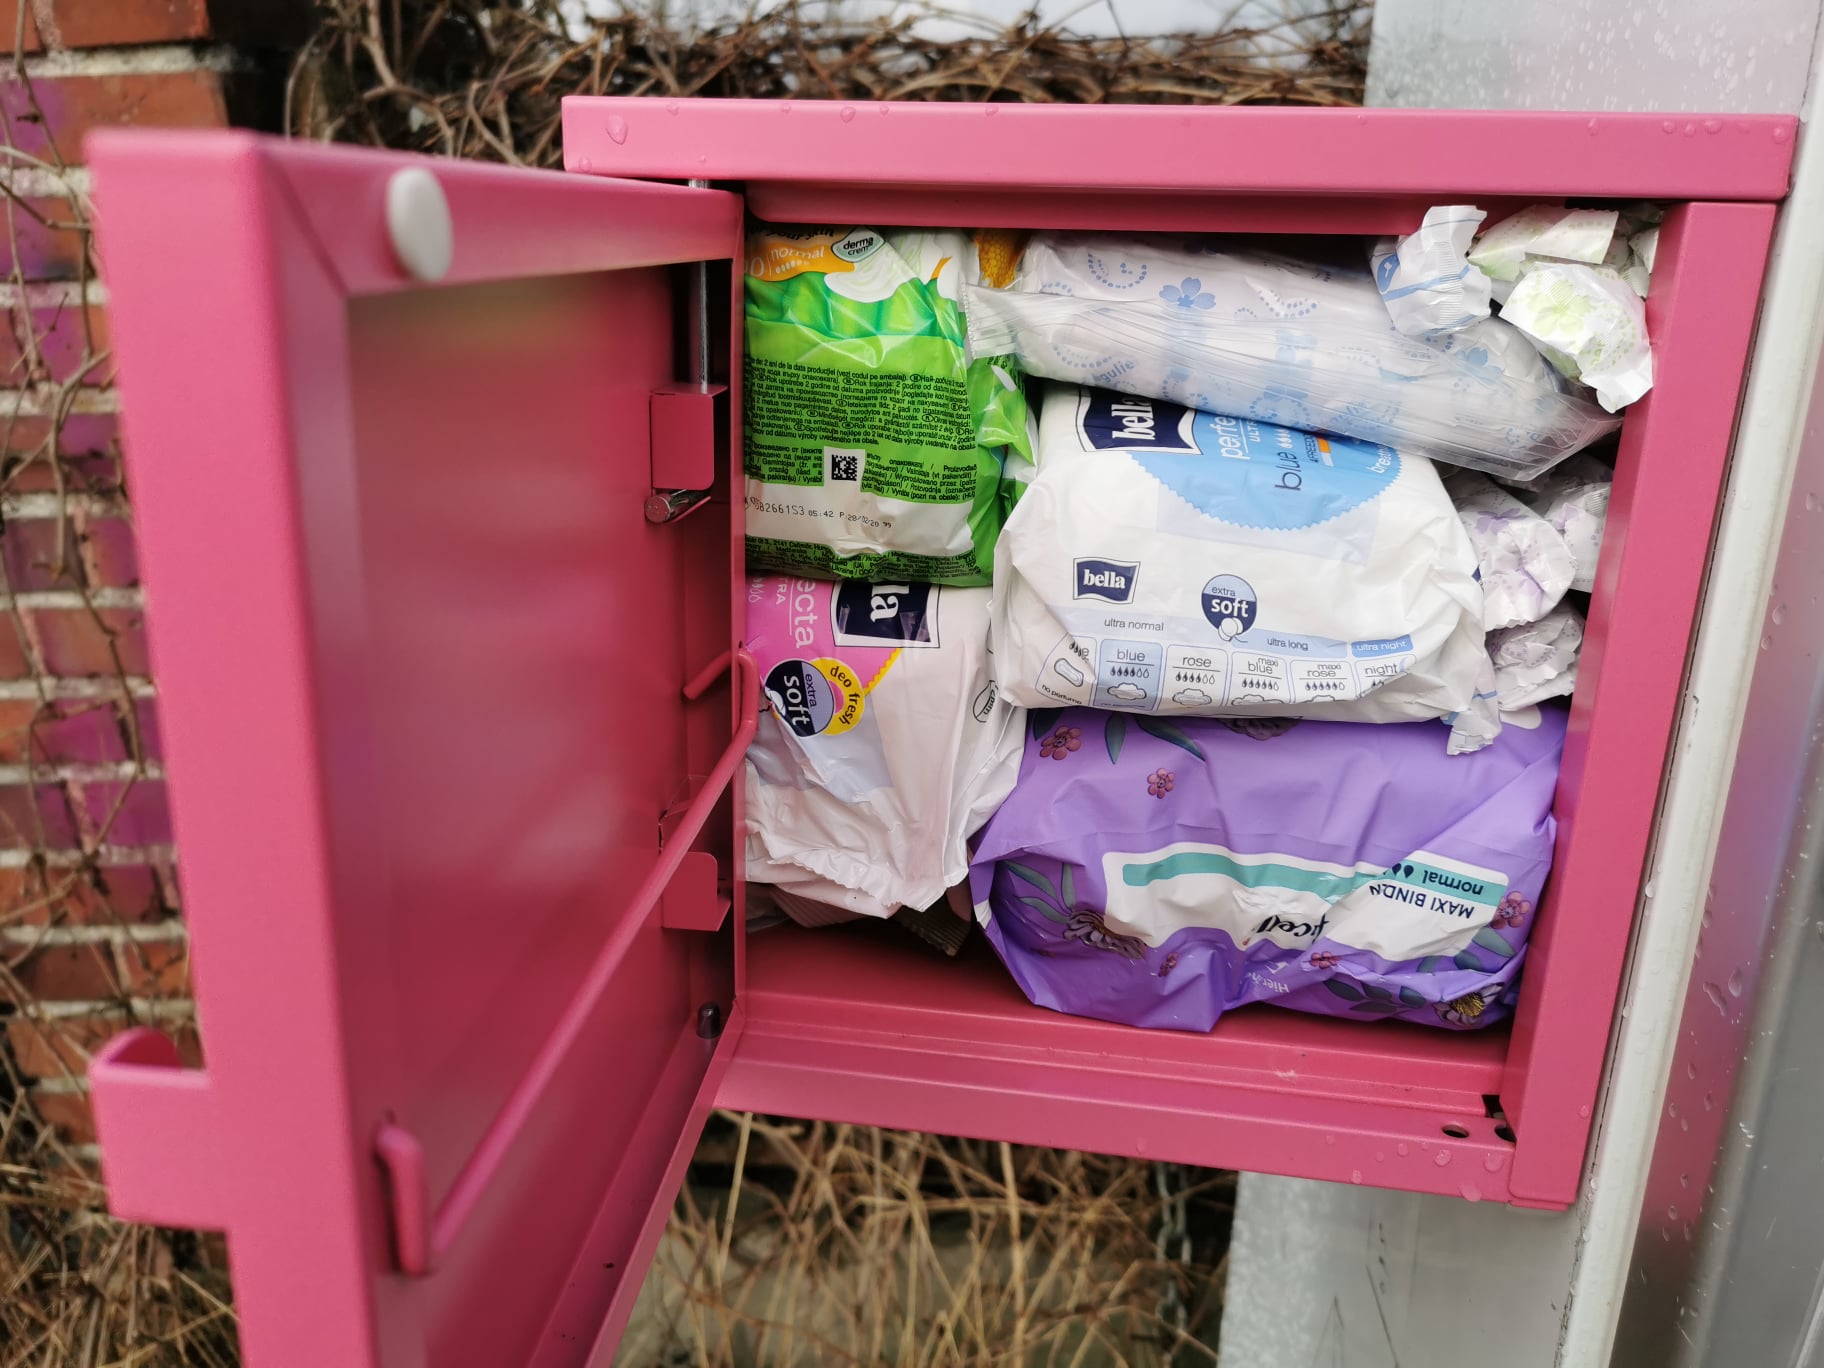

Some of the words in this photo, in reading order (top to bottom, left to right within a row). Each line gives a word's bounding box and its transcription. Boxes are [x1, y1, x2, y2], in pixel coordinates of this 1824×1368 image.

[842, 236, 875, 250] derma
[770, 246, 825, 259] normal
[1274, 451, 1302, 491] blue
[1083, 569, 1126, 589] bella
[1211, 585, 1236, 598] extra
[1210, 598, 1249, 618] soft
[1104, 618, 1126, 628] ultra
[1128, 620, 1165, 632] normal
[1267, 637, 1287, 648] ultra
[1287, 639, 1309, 651] long
[1116, 648, 1146, 662] blue
[1182, 656, 1212, 668] rose
[1257, 656, 1279, 667] maxi
[1247, 660, 1273, 675] blue
[1307, 668, 1336, 678] rose
[1317, 662, 1342, 671] maxi
[1364, 663, 1398, 677] night
[830, 665, 853, 689] deo
[804, 673, 818, 708] extra
[783, 674, 811, 726] soft
[838, 690, 861, 725] fresh
[1422, 869, 1484, 896] normal
[1429, 894, 1475, 920] MAXI
